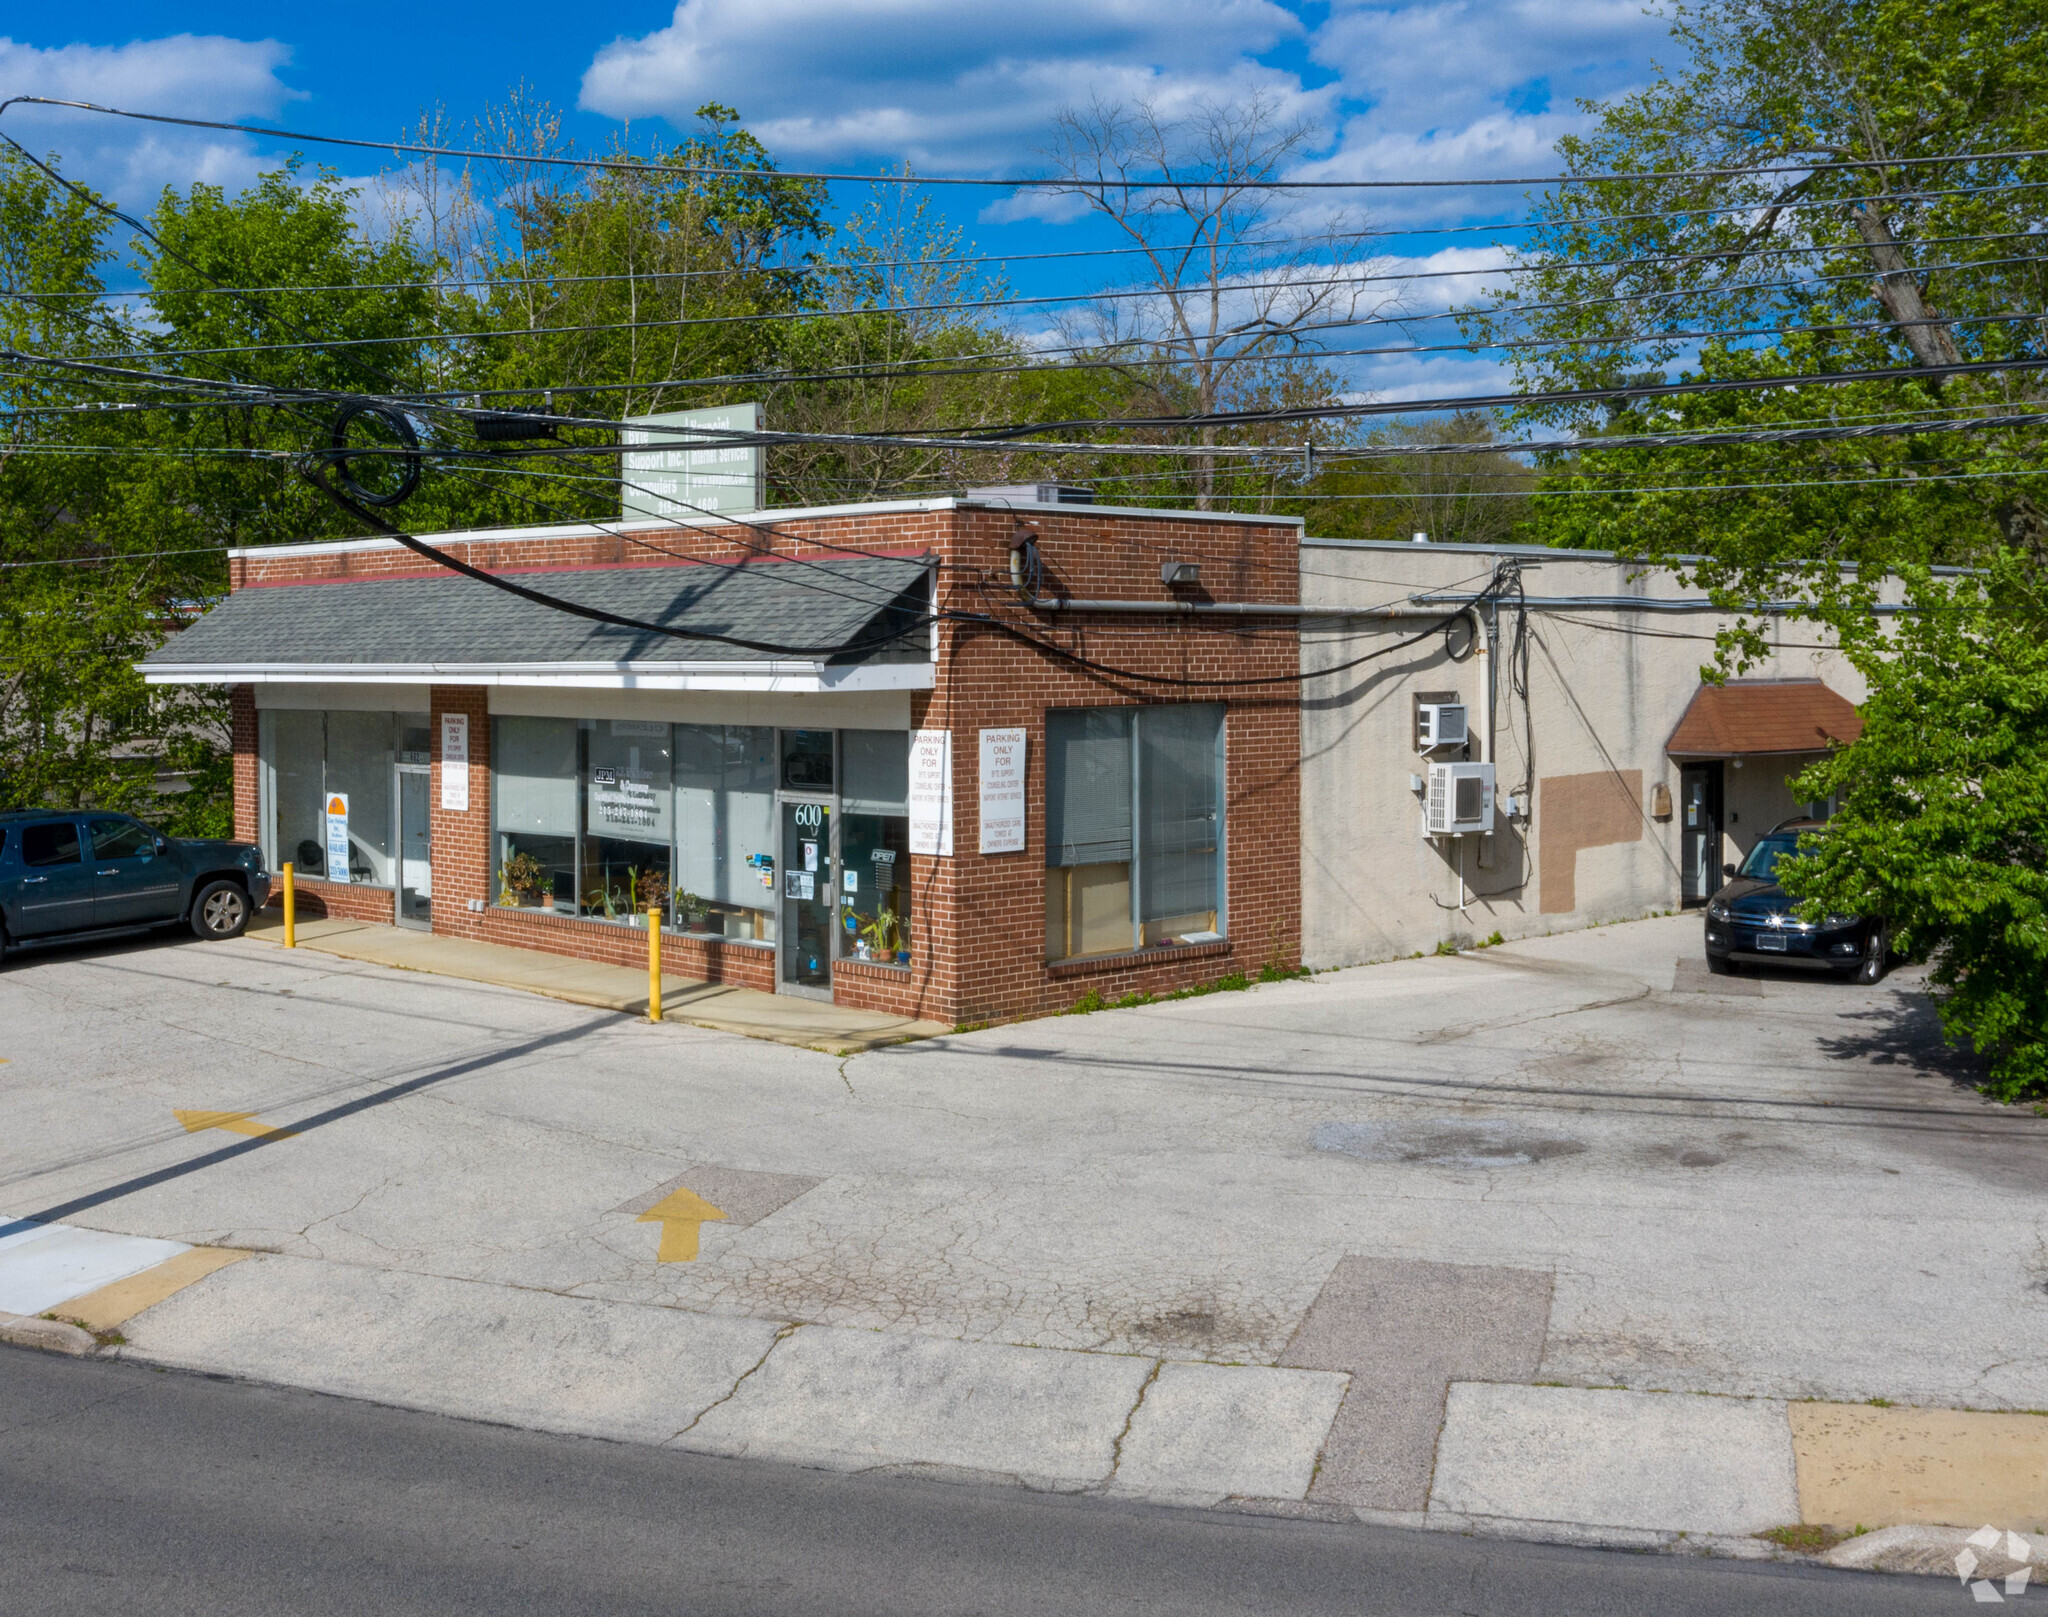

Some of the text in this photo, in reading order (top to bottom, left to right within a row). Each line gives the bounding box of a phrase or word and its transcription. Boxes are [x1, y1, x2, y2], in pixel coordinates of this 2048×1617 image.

[691, 447, 749, 466] Internet Services
[628, 450, 685, 473] Support Inc.
[628, 477, 677, 499] Computers
[444, 717, 465, 725] PARKING
[448, 726, 460, 734] ONLY
[914, 735, 946, 744] PARKING
[986, 734, 1021, 744] PARKING
[920, 747, 939, 756] ONLY
[993, 746, 1013, 755] ONLY
[922, 758, 937, 767] FOR
[995, 757, 1011, 766] FOR
[597, 770, 613, 780] JPM
[795, 804, 822, 827] 600
[873, 851, 895, 862] OPEN
